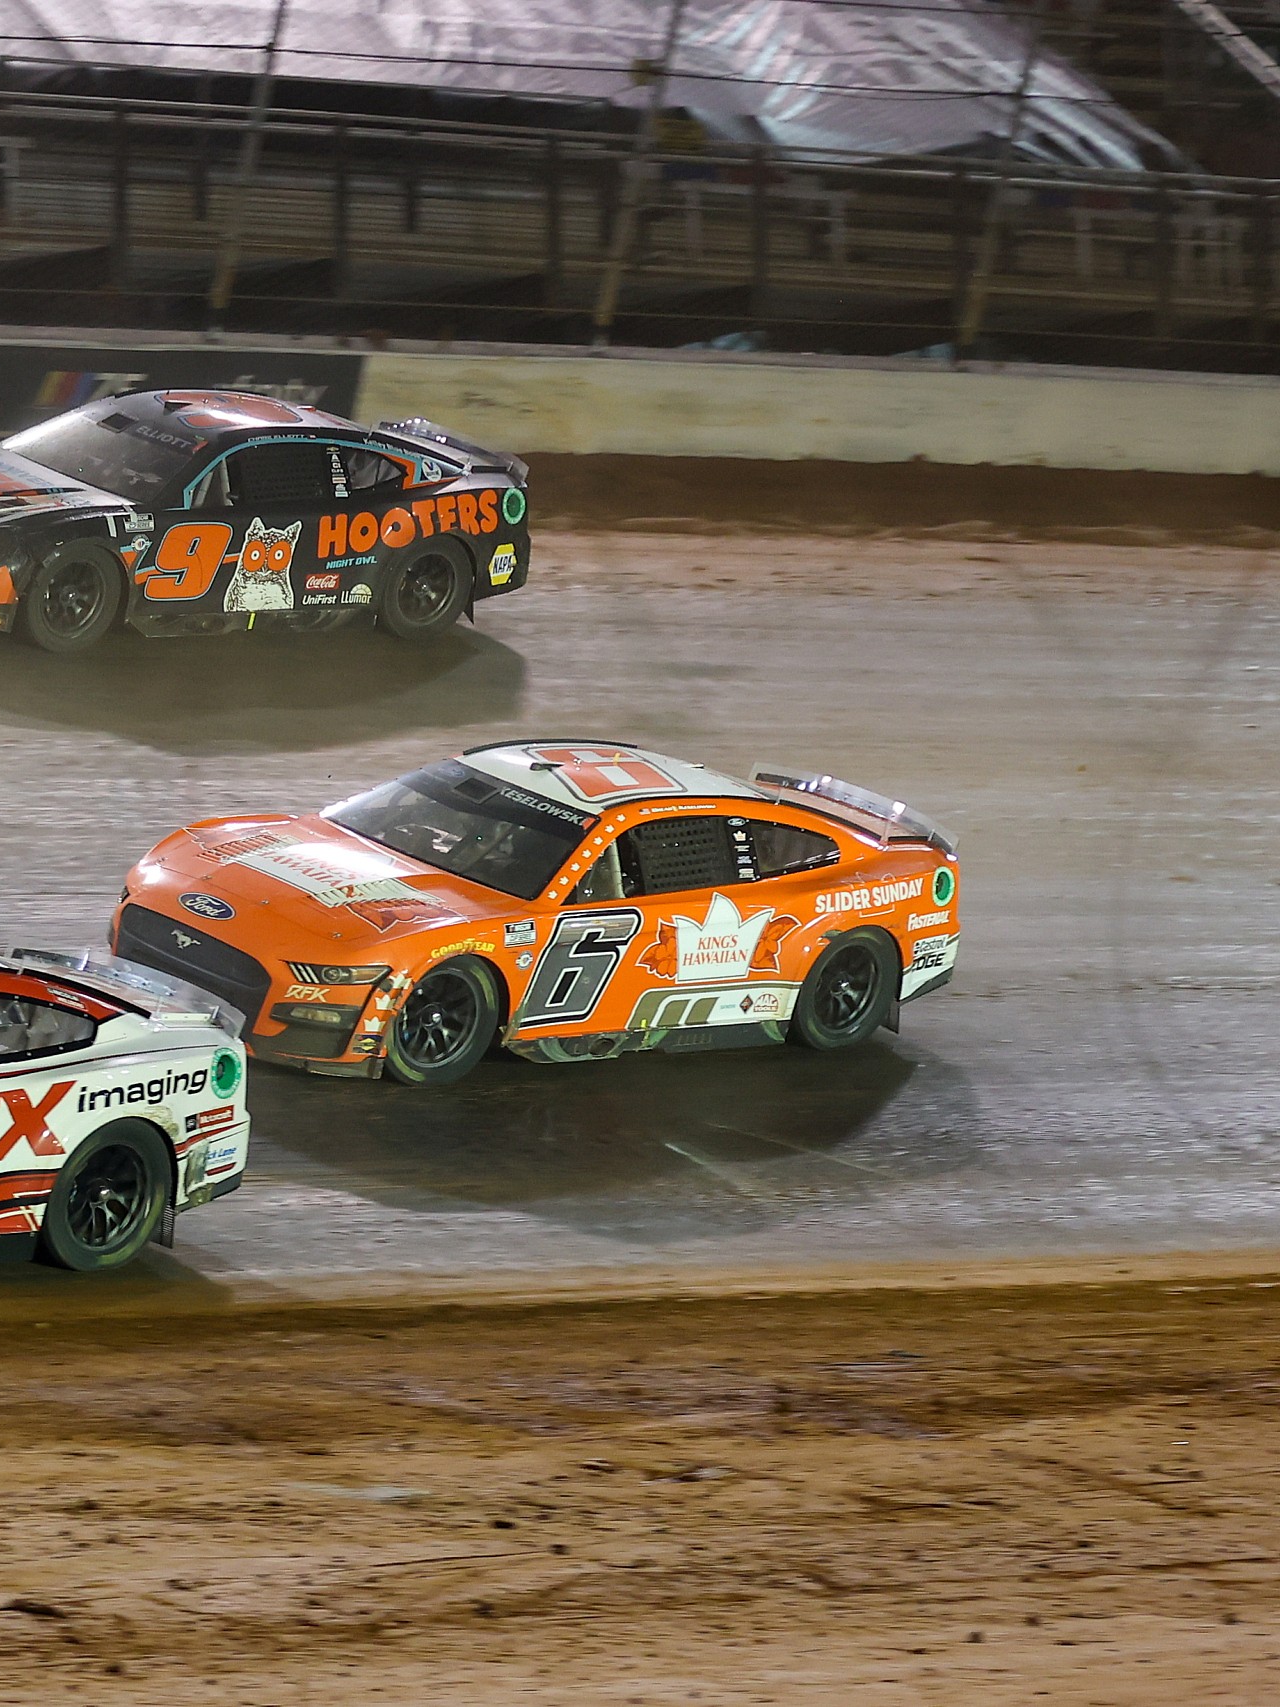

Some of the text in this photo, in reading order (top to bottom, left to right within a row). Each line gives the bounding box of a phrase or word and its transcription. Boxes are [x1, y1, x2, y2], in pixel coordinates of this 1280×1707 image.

[136, 425, 192, 449] ELLIOTT
[317, 489, 499, 558] HOOTERS
[144, 522, 233, 601] 9
[326, 556, 378, 570] NIGHT OWL
[302, 593, 337, 605] UniFirst
[498, 786, 585, 826] KESELOWSKI
[183, 894, 230, 918] Ford
[815, 889, 871, 913] SLIDER
[873, 878, 925, 907] SUNDAY
[430, 938, 496, 960] GOODYEAR
[697, 934, 738, 950] KING'S
[519, 907, 645, 1030] 6
[682, 949, 749, 967] HAWAIIAN
[284, 985, 331, 1003] RFK
[77, 1069, 208, 1112] imaging
